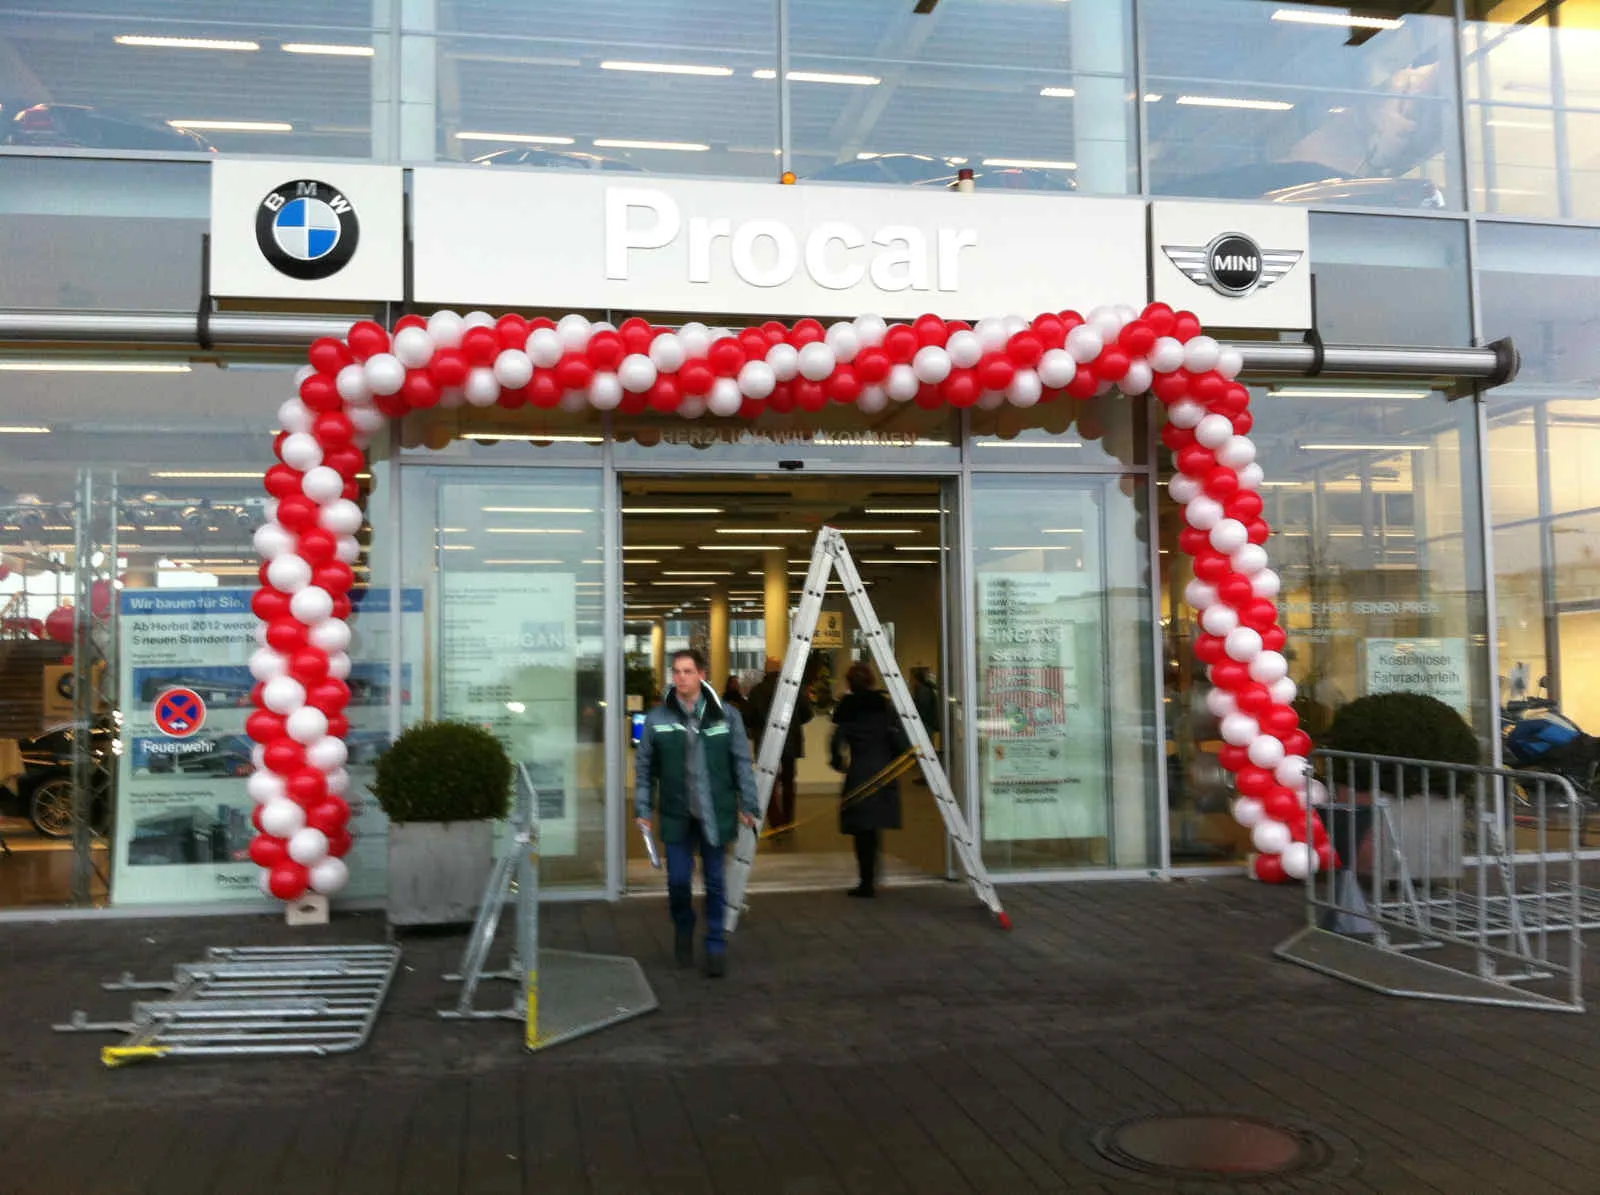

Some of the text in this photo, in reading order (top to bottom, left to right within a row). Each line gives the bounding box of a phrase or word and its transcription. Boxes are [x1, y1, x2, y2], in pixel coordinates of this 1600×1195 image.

[263, 181, 352, 215] BMW
[605, 186, 978, 292] Procar
[1214, 255, 1257, 272] MINI
[659, 428, 768, 445] HERZLICH
[130, 598, 153, 609] Wir
[156, 597, 196, 609] bauen
[133, 621, 150, 632] Ab
[142, 635, 178, 646] neuen
[1378, 654, 1452, 668] Kostenloser
[1373, 670, 1461, 685] Fahrradverleih
[143, 739, 216, 753] Feuerwehr
